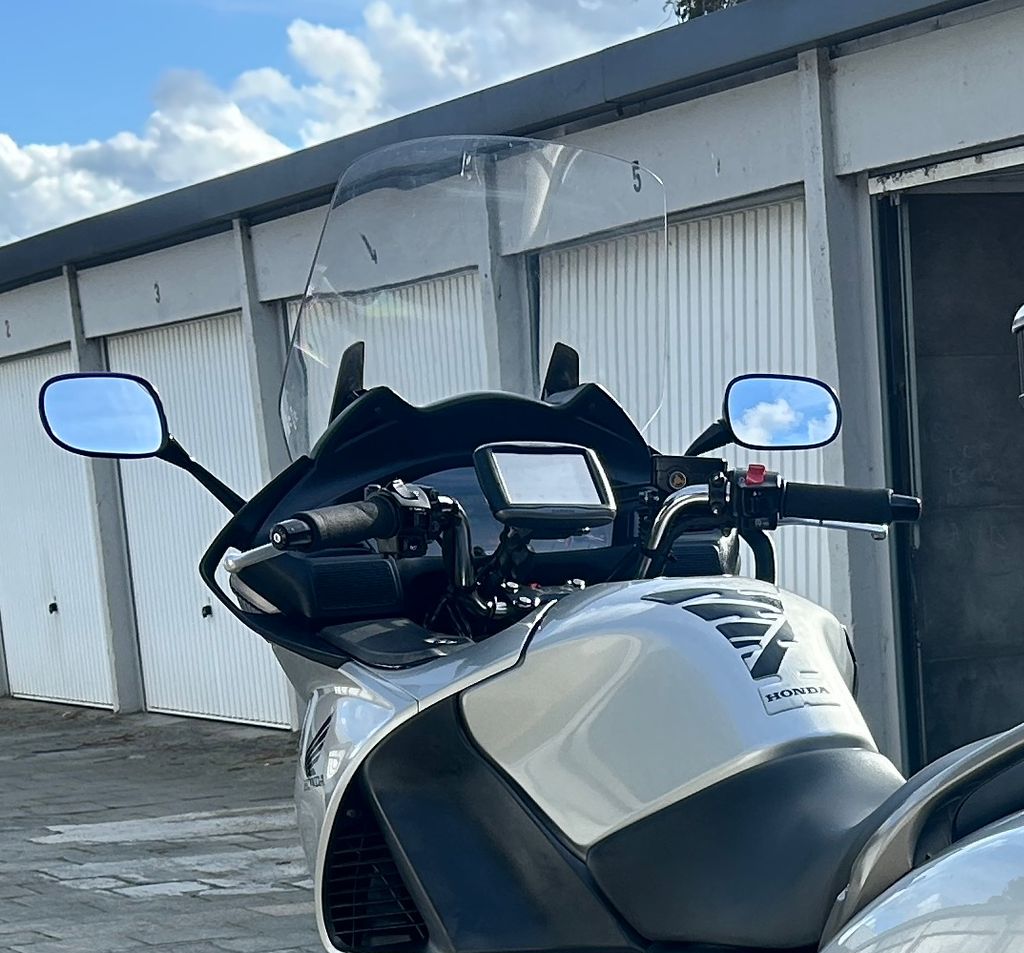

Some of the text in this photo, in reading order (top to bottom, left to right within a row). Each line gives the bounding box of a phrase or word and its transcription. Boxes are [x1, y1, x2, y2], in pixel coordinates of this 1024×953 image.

[632, 160, 641, 193] 5
[154, 283, 161, 304] 3
[765, 686, 831, 703] HONDA
